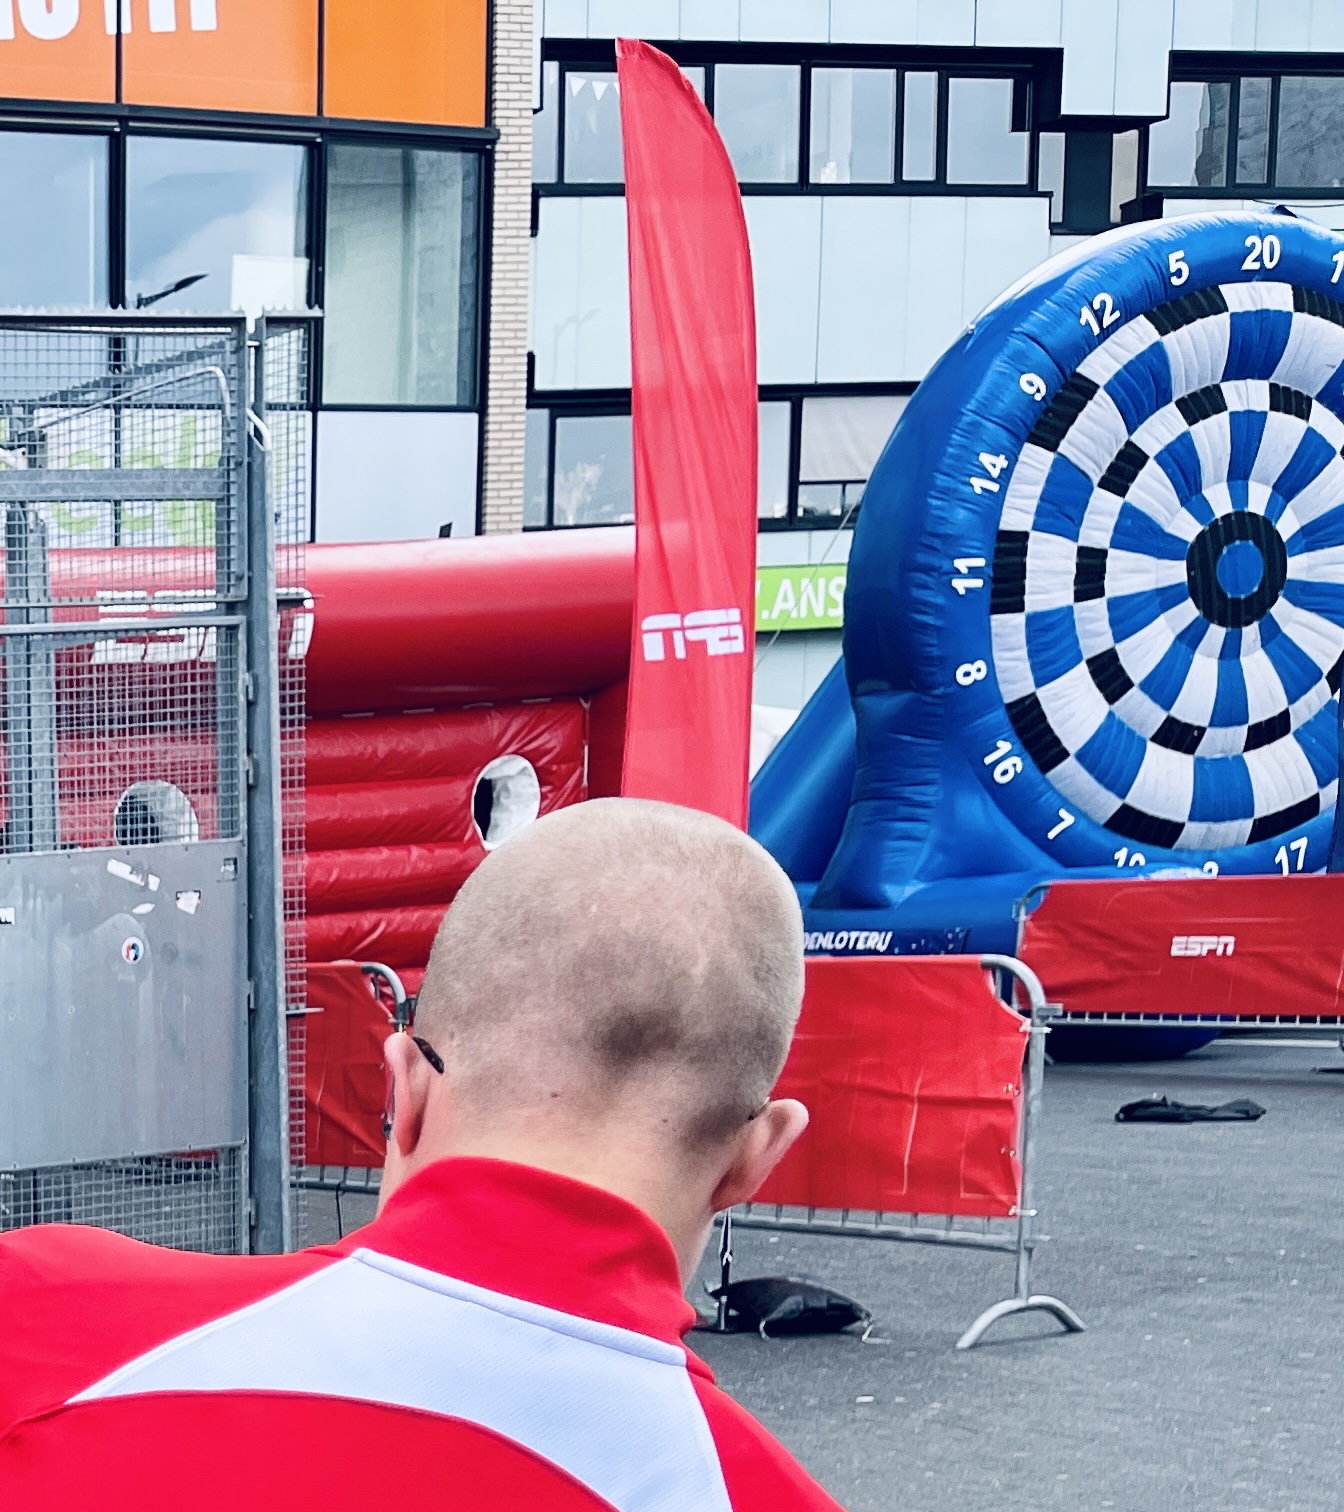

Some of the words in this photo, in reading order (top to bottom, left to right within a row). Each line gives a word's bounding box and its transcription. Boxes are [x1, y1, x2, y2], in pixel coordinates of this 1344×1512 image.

[1167, 249, 1190, 286] 5
[1241, 234, 1281, 270] 20
[1079, 292, 1121, 335] 12
[1019, 372, 1048, 401] 9
[969, 450, 1009, 496] 14
[951, 556, 986, 596] 11
[955, 659, 988, 686] 8
[983, 739, 1024, 785] 16
[1047, 808, 1076, 841] 7
[1274, 836, 1309, 876] 17
[1170, 935, 1236, 957] ESPN
